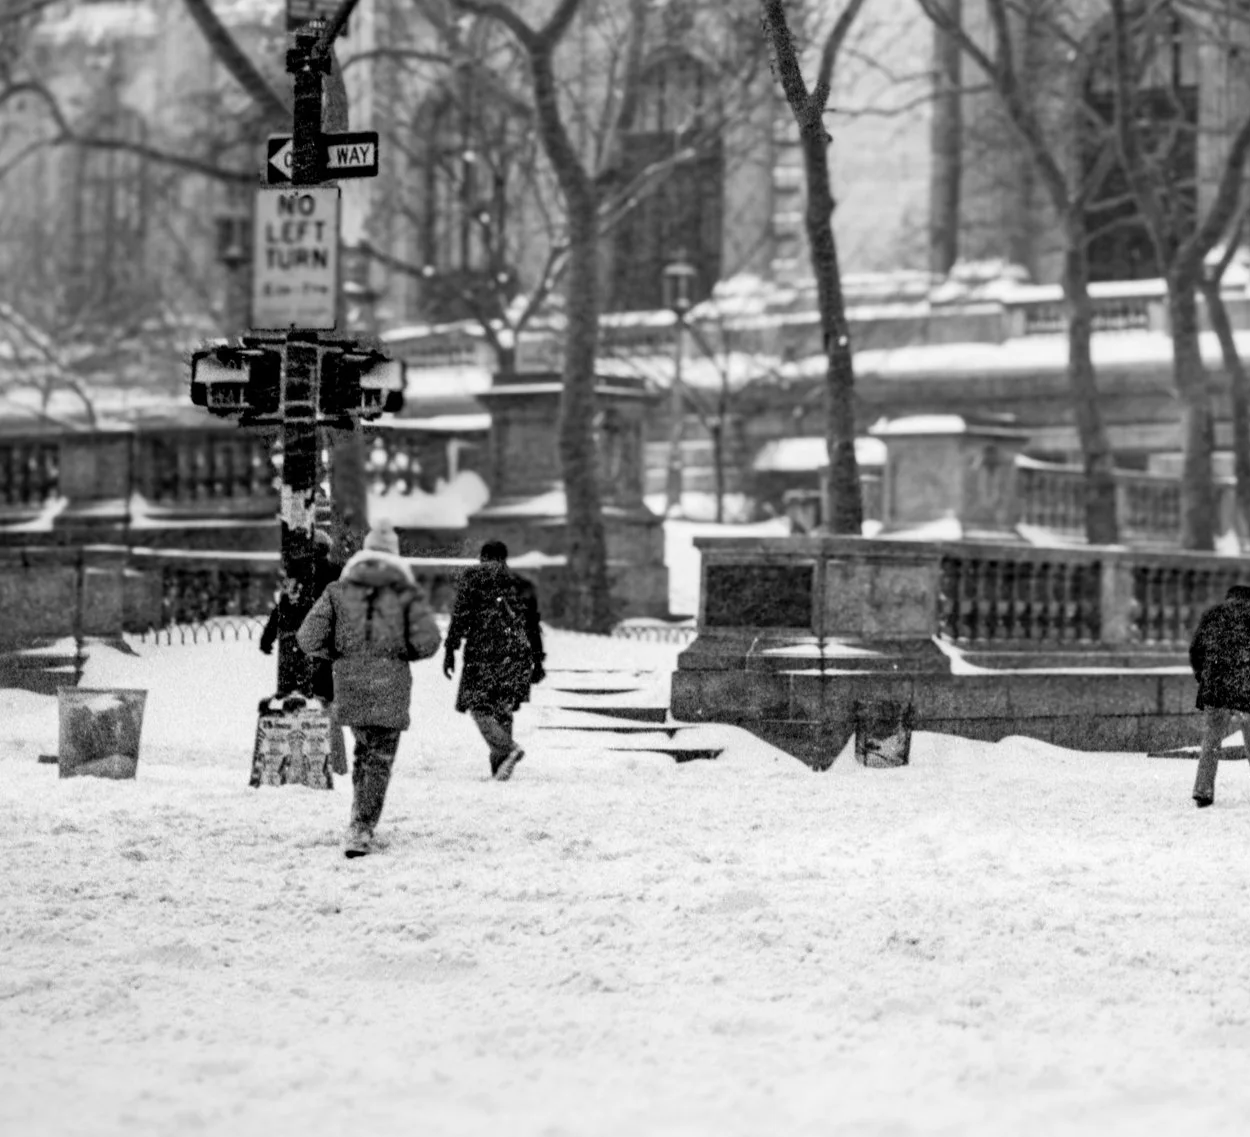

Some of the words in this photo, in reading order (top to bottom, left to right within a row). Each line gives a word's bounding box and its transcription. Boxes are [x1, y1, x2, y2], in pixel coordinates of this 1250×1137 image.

[337, 145, 370, 164] WAY
[278, 194, 315, 215] NO
[265, 220, 326, 244] LEFT
[265, 248, 328, 270] TURN
